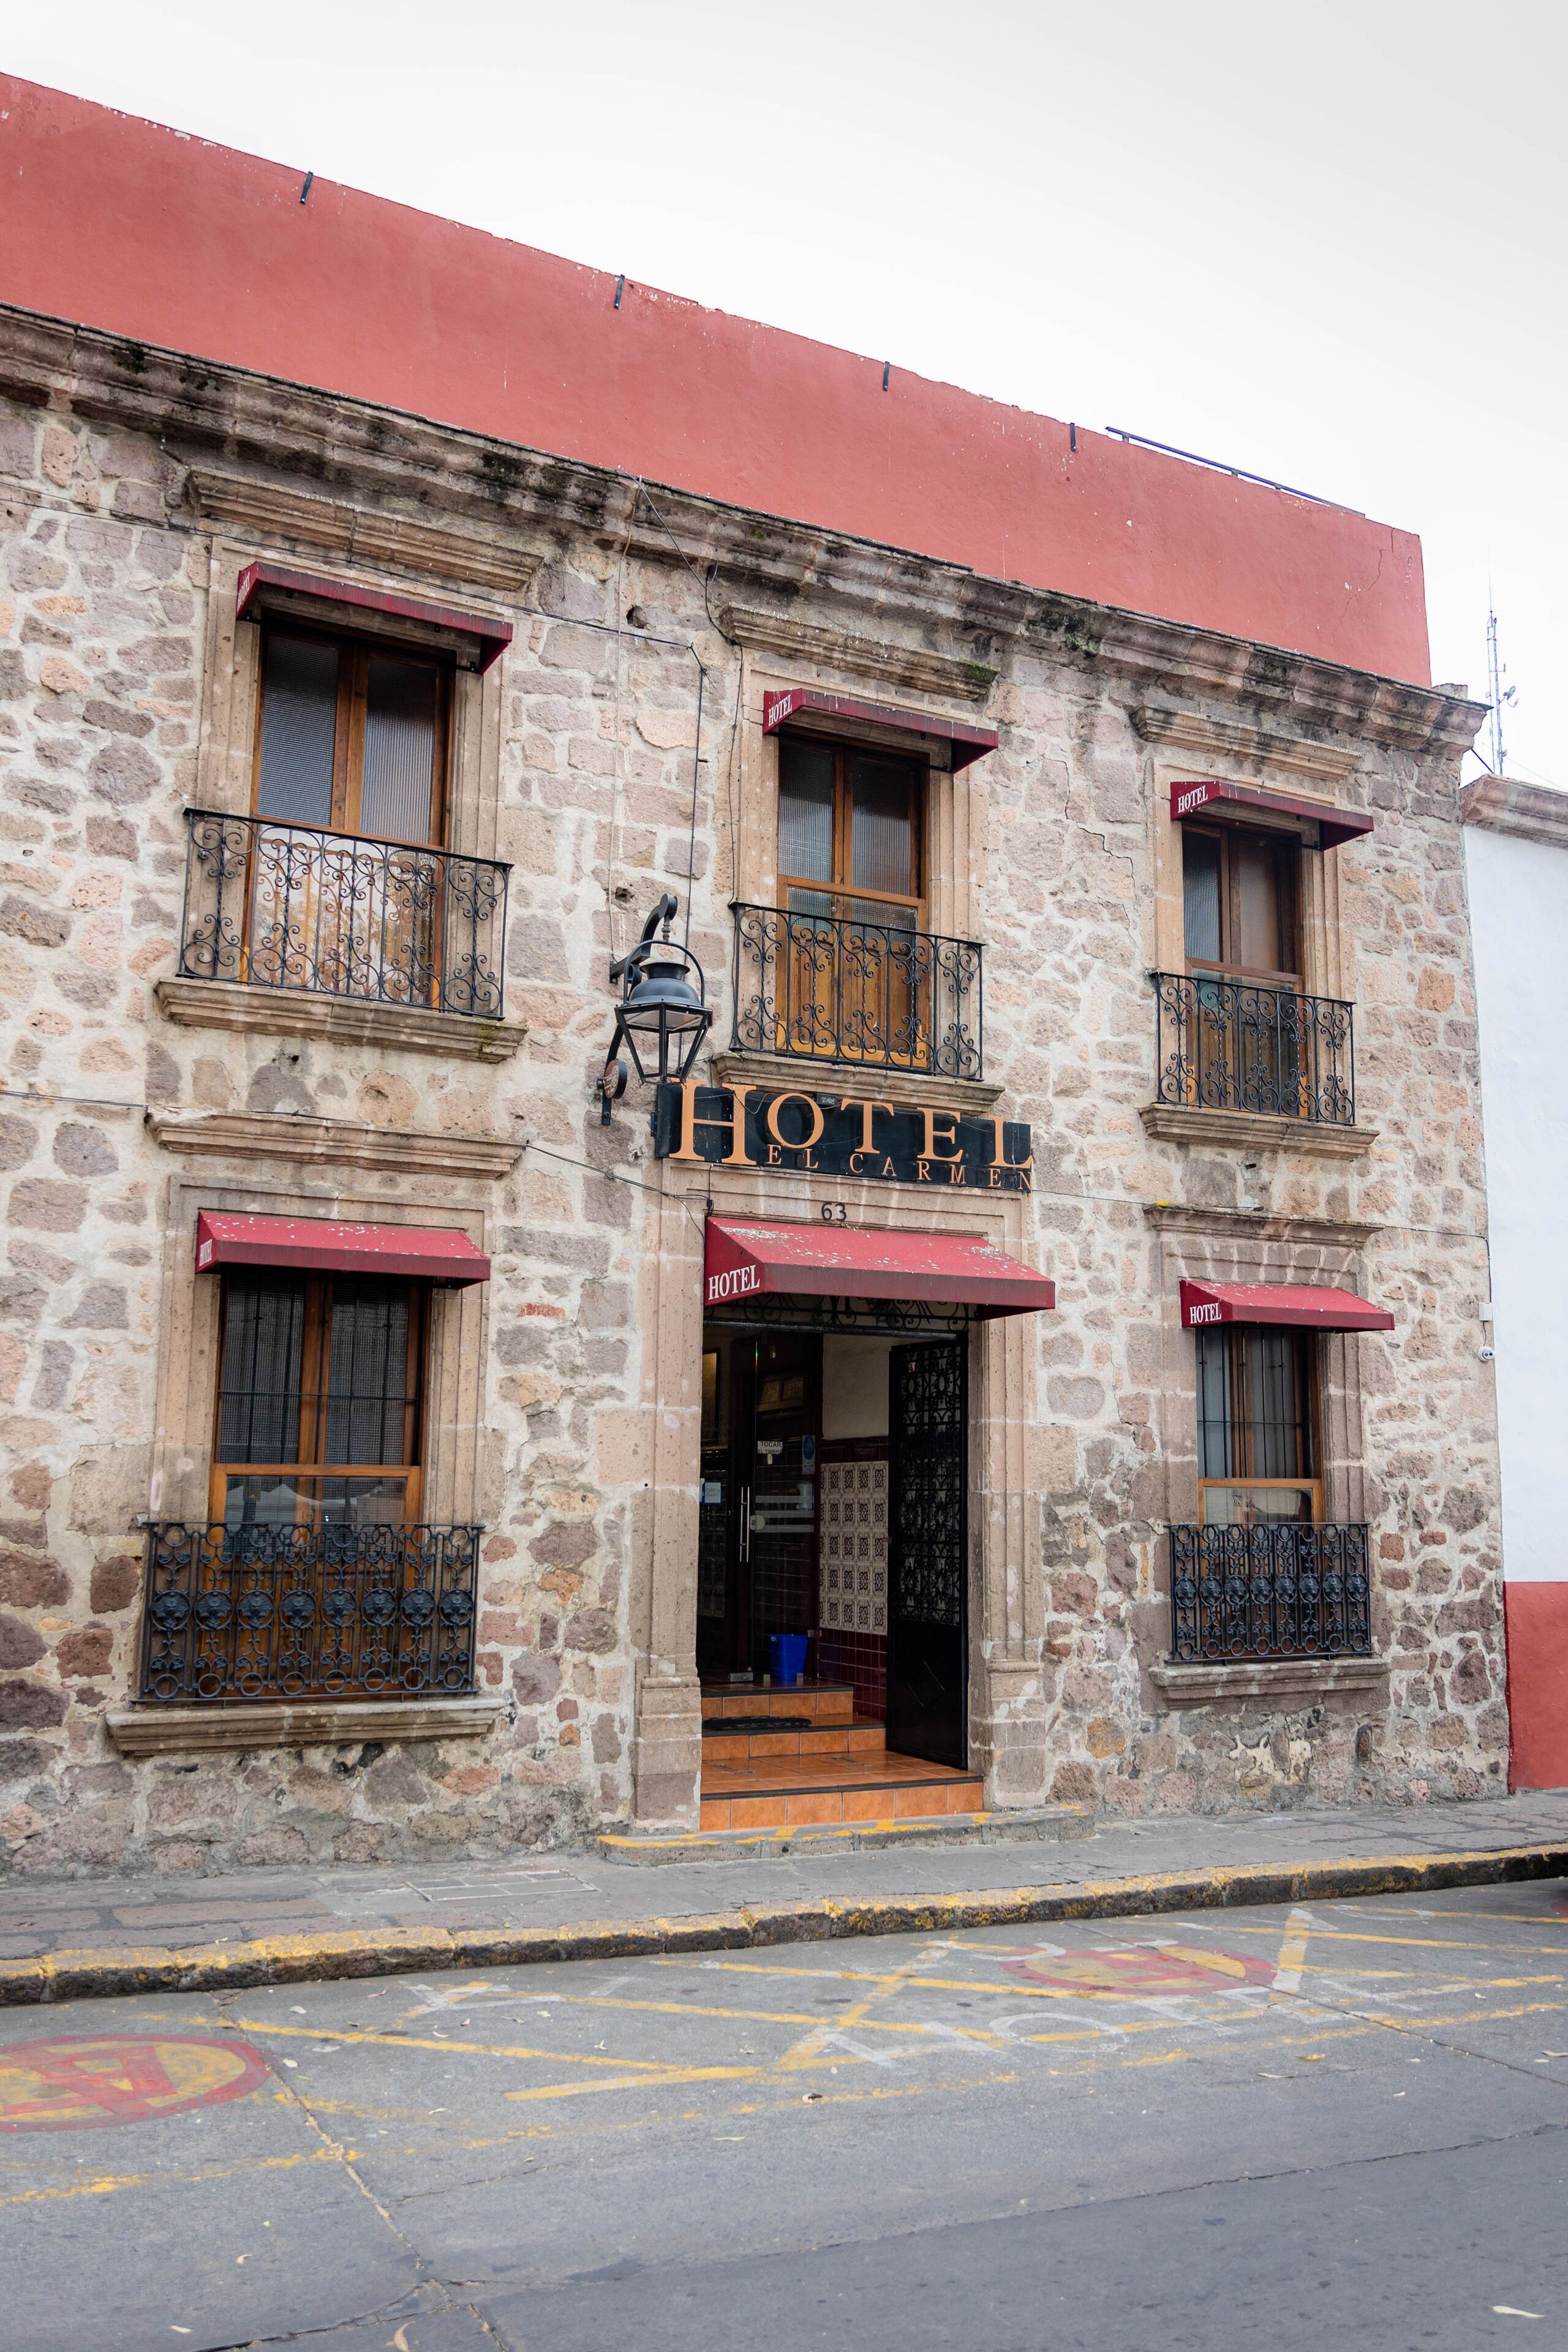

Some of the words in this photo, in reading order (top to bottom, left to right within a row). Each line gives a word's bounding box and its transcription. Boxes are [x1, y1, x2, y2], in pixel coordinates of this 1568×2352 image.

[768, 693, 793, 727] HOTEL
[1177, 785, 1208, 813] HOTEL
[669, 1077, 1033, 1169] HOTEL
[766, 1144, 818, 1169] EL
[849, 1153, 1032, 1190] CARMEN
[821, 1202, 847, 1222] 63
[708, 1264, 760, 1300] HOTEL
[1189, 1302, 1222, 1324] HOTEL
